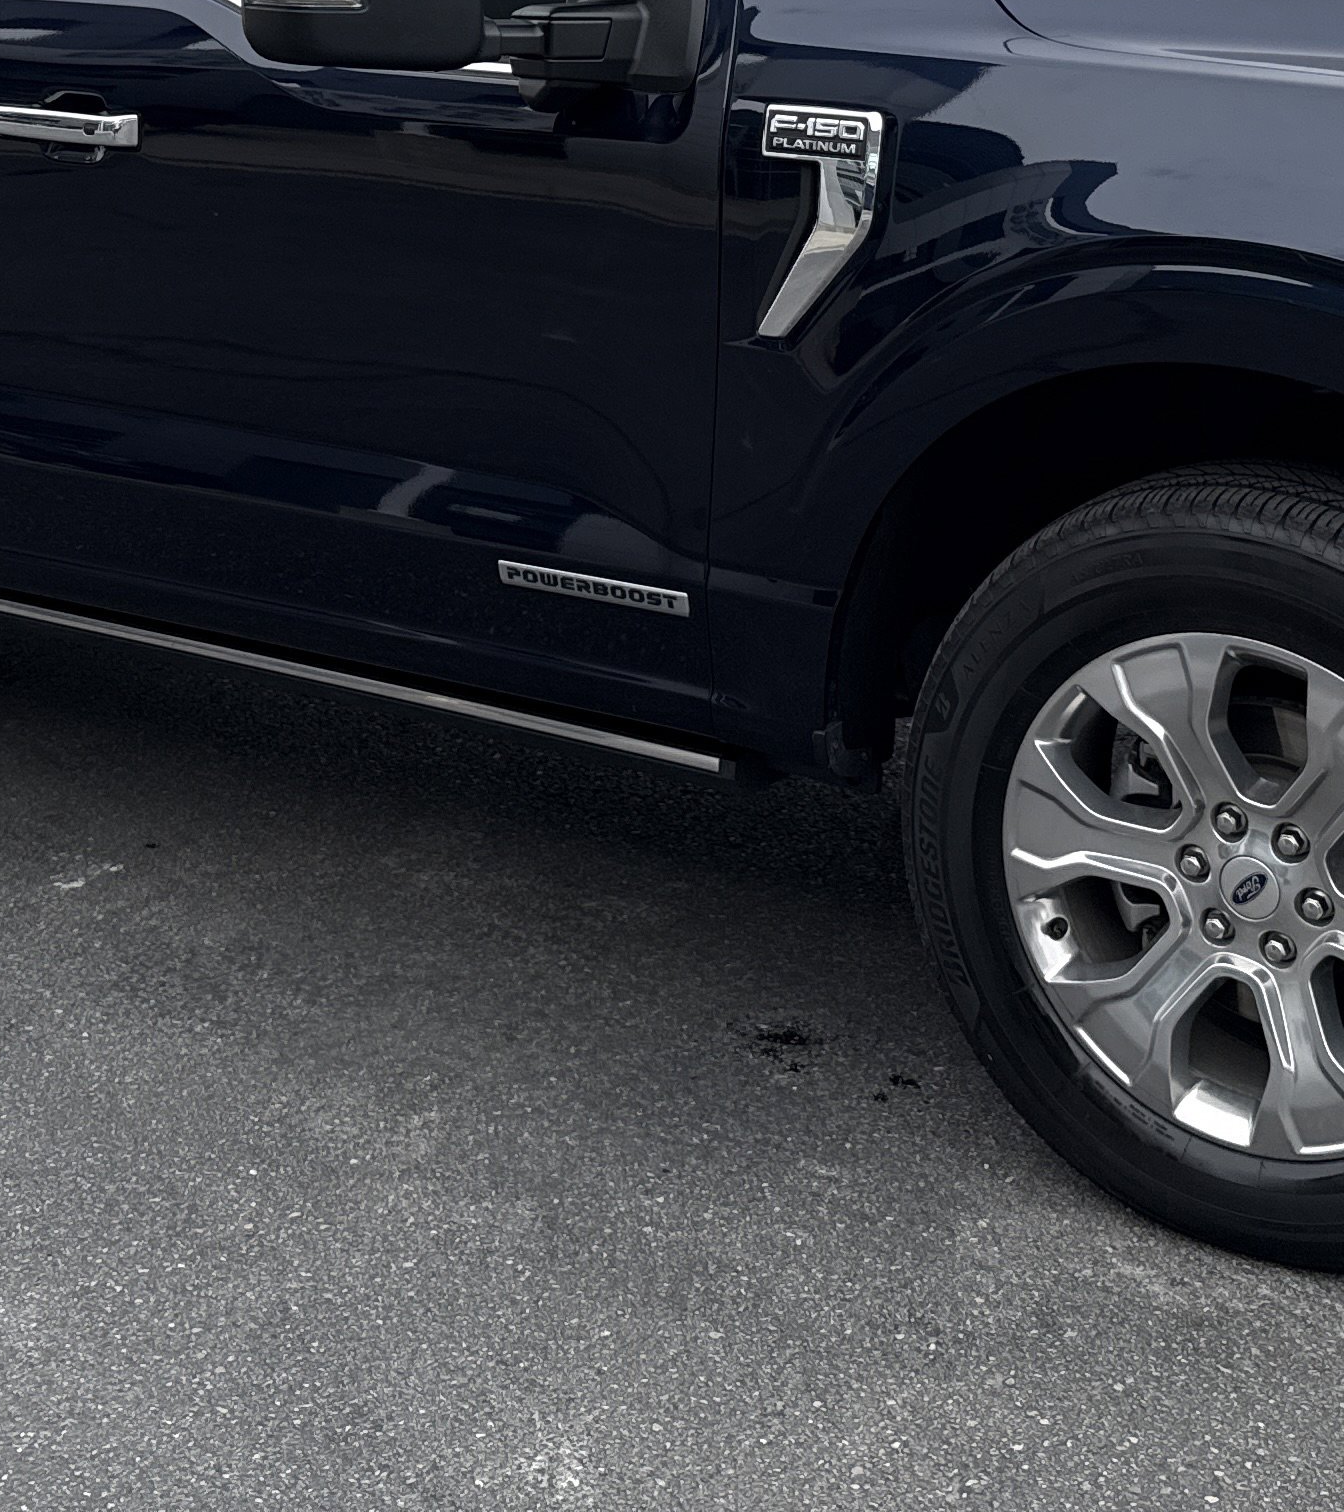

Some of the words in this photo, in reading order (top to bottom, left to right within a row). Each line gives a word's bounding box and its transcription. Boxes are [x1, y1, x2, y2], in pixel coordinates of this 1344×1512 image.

[769, 114, 866, 141] F-150
[772, 136, 856, 154] PLATINUM
[507, 566, 678, 609] POWERBOOST
[1235, 874, 1264, 904] Ford
